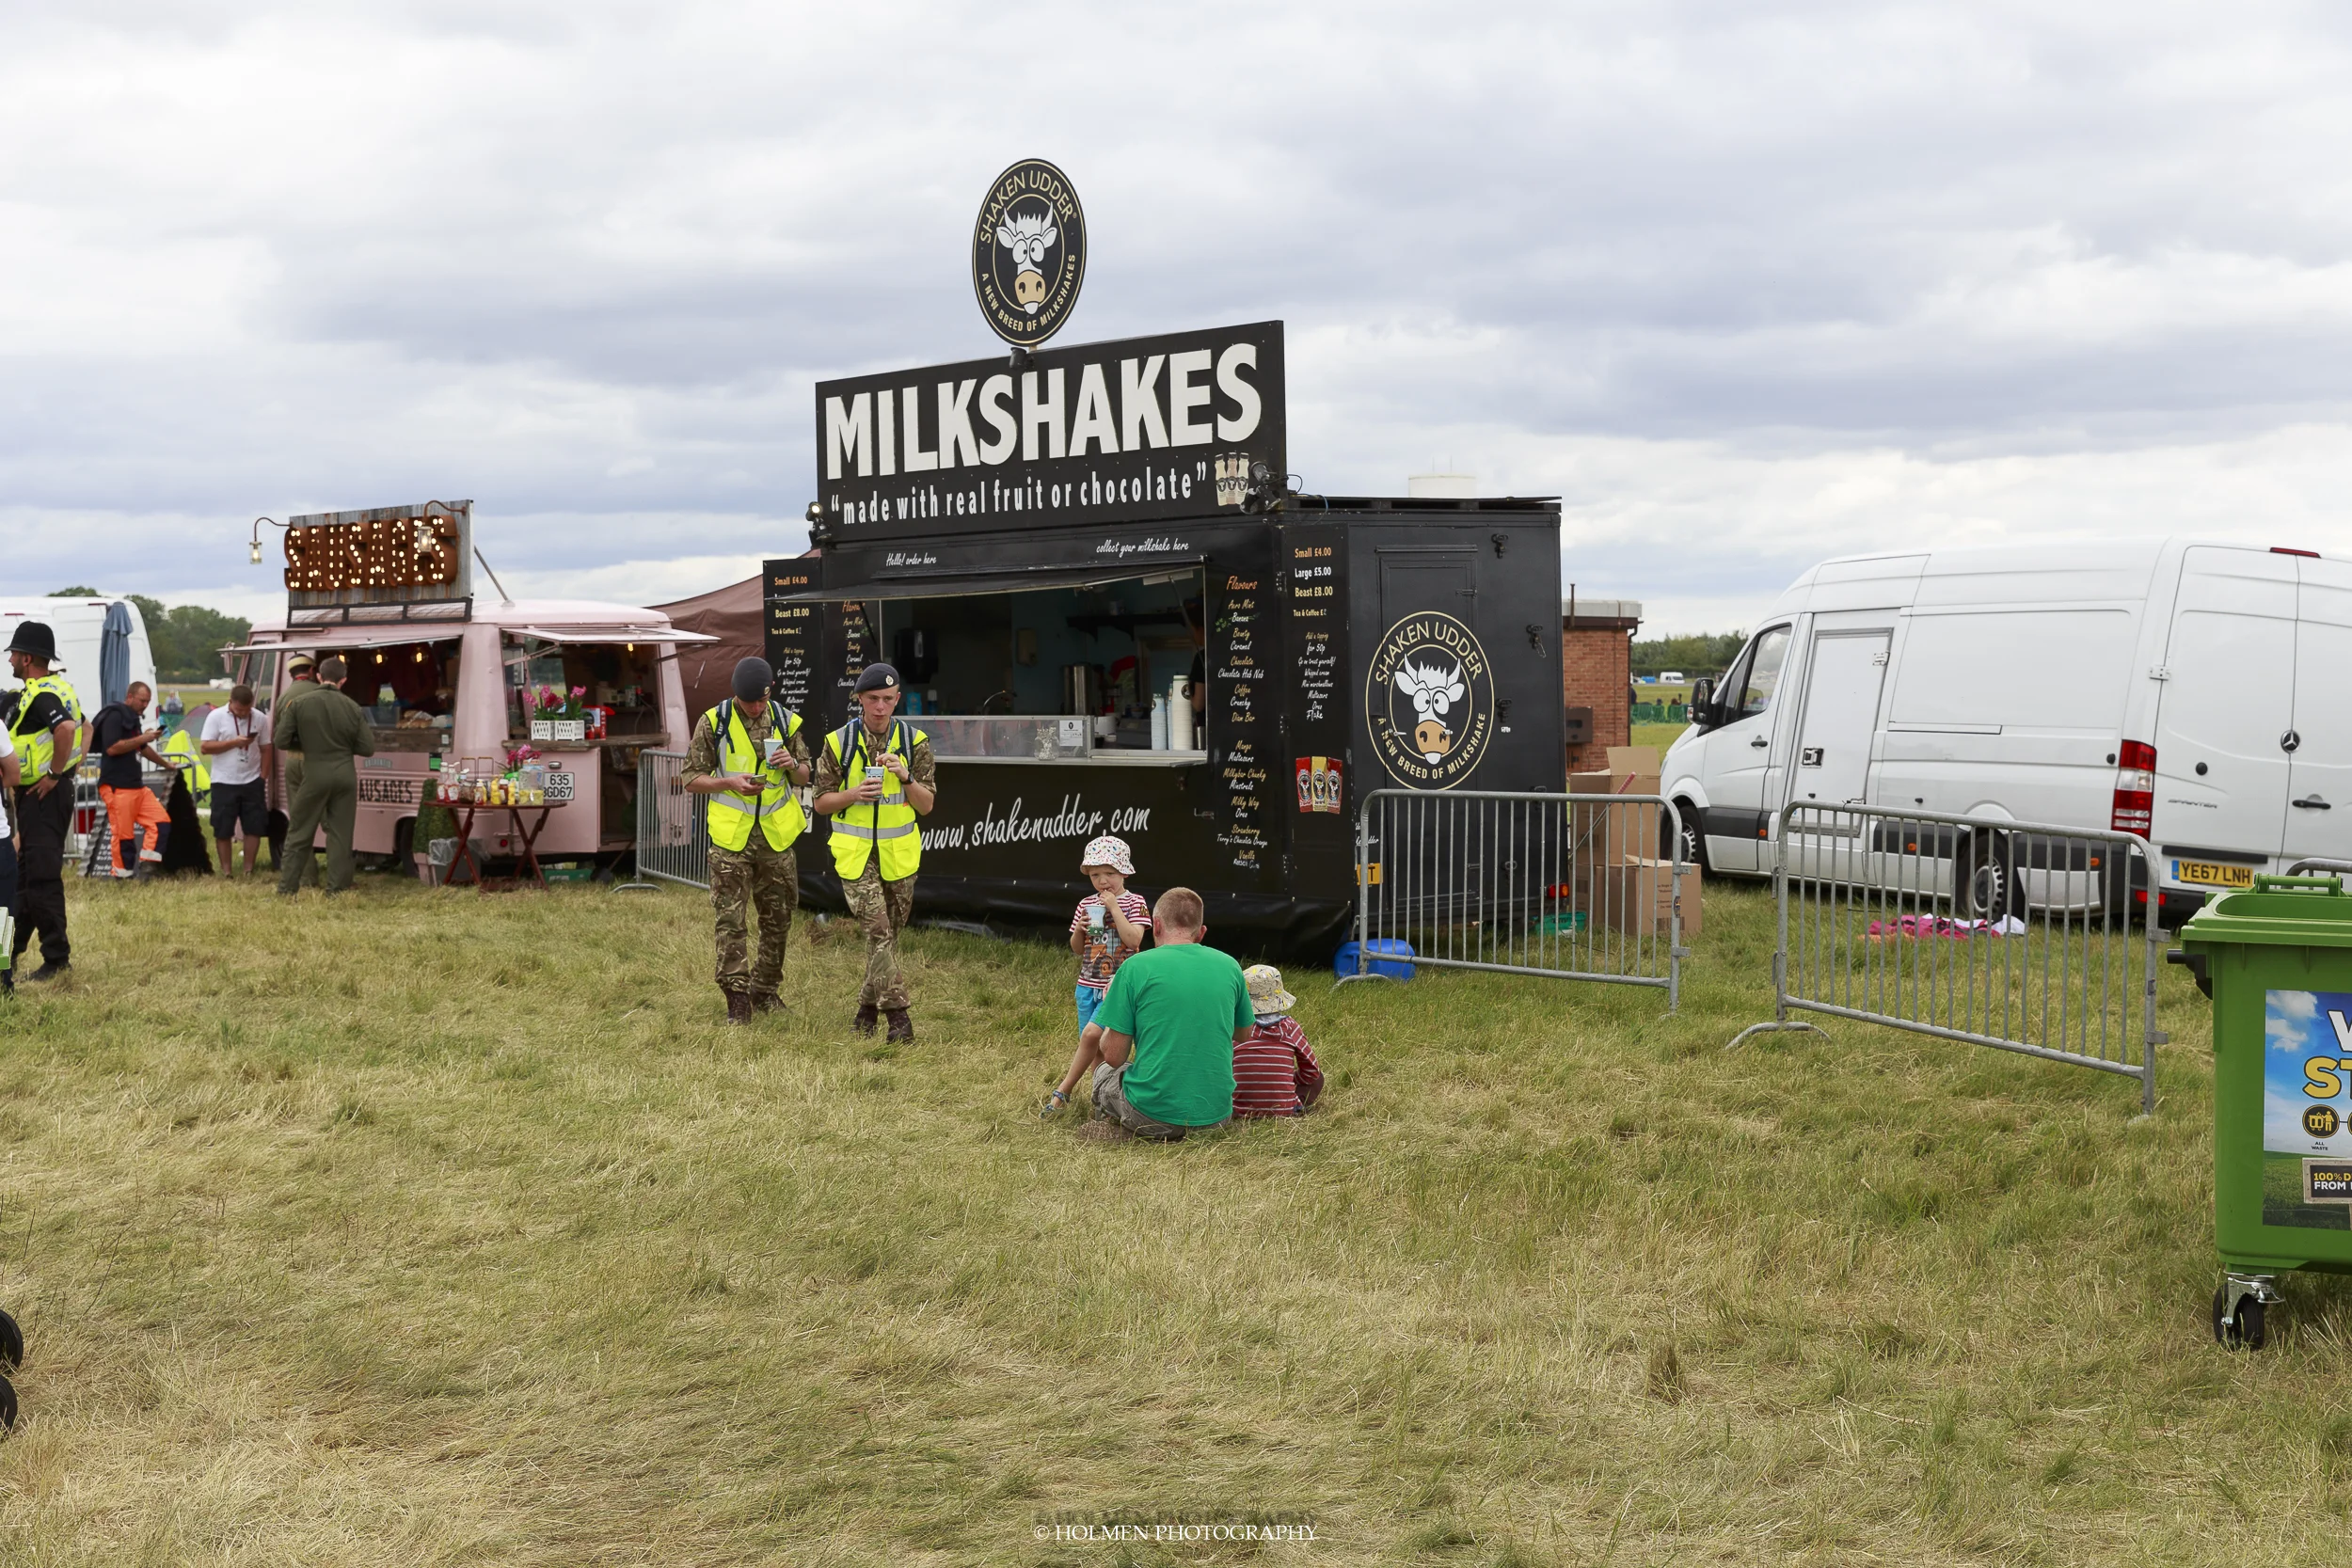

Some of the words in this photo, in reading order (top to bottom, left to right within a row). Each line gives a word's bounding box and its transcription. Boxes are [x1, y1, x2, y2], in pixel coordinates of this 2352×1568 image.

[980, 171, 1025, 244] SHAKEN
[1030, 170, 1073, 223] UDDER
[981, 273, 990, 281] A
[984, 284, 998, 310] NEW
[1040, 254, 1076, 326] MILKSHAKES
[997, 309, 1023, 332] BREED
[1026, 320, 1038, 332] OF
[825, 342, 1262, 480] MILKSHAKES
[898, 483, 938, 520] with
[946, 478, 985, 516] real
[993, 475, 1043, 513] fruit
[1052, 482, 1073, 509] or
[284, 515, 458, 590] SAUSAGES
[1096, 539, 1120, 553] collect
[1119, 545, 1136, 558] your
[1137, 537, 1170, 552] milkshake
[1172, 537, 1189, 551] here
[1295, 547, 1312, 559] Small
[1314, 546, 1331, 558] £4.00
[886, 552, 906, 567] Hello!
[906, 553, 922, 565] order
[923, 552, 937, 564] here
[1295, 567, 1312, 580] Large
[1314, 566, 1332, 577] £5.00
[774, 577, 790, 586] Small
[792, 576, 808, 585] £4.00
[1226, 575, 1258, 591] Flavours
[1295, 587, 1313, 598] Beast
[1314, 586, 1333, 597] £8.00
[775, 609, 791, 619] Beast
[793, 608, 809, 617] £8.00
[1230, 640, 1252, 651] Caramel
[1375, 621, 1429, 685] SHAKEN
[1435, 621, 1483, 680] UDDER
[1244, 711, 1256, 722] Bar
[1377, 718, 1387, 726] A
[1381, 730, 1398, 757] NEW
[1398, 755, 1428, 780] BREED
[1432, 768, 1445, 780] OF
[550, 774, 569, 786] 635
[359, 779, 413, 803] AUSAGES
[921, 793, 1151, 850] www.shakenudder.com
[2179, 862, 2218, 881] YE67
[2223, 866, 2252, 885] LNH
[2313, 1172, 2343, 1181] 100%
[2313, 1180, 2346, 1191] FROM
